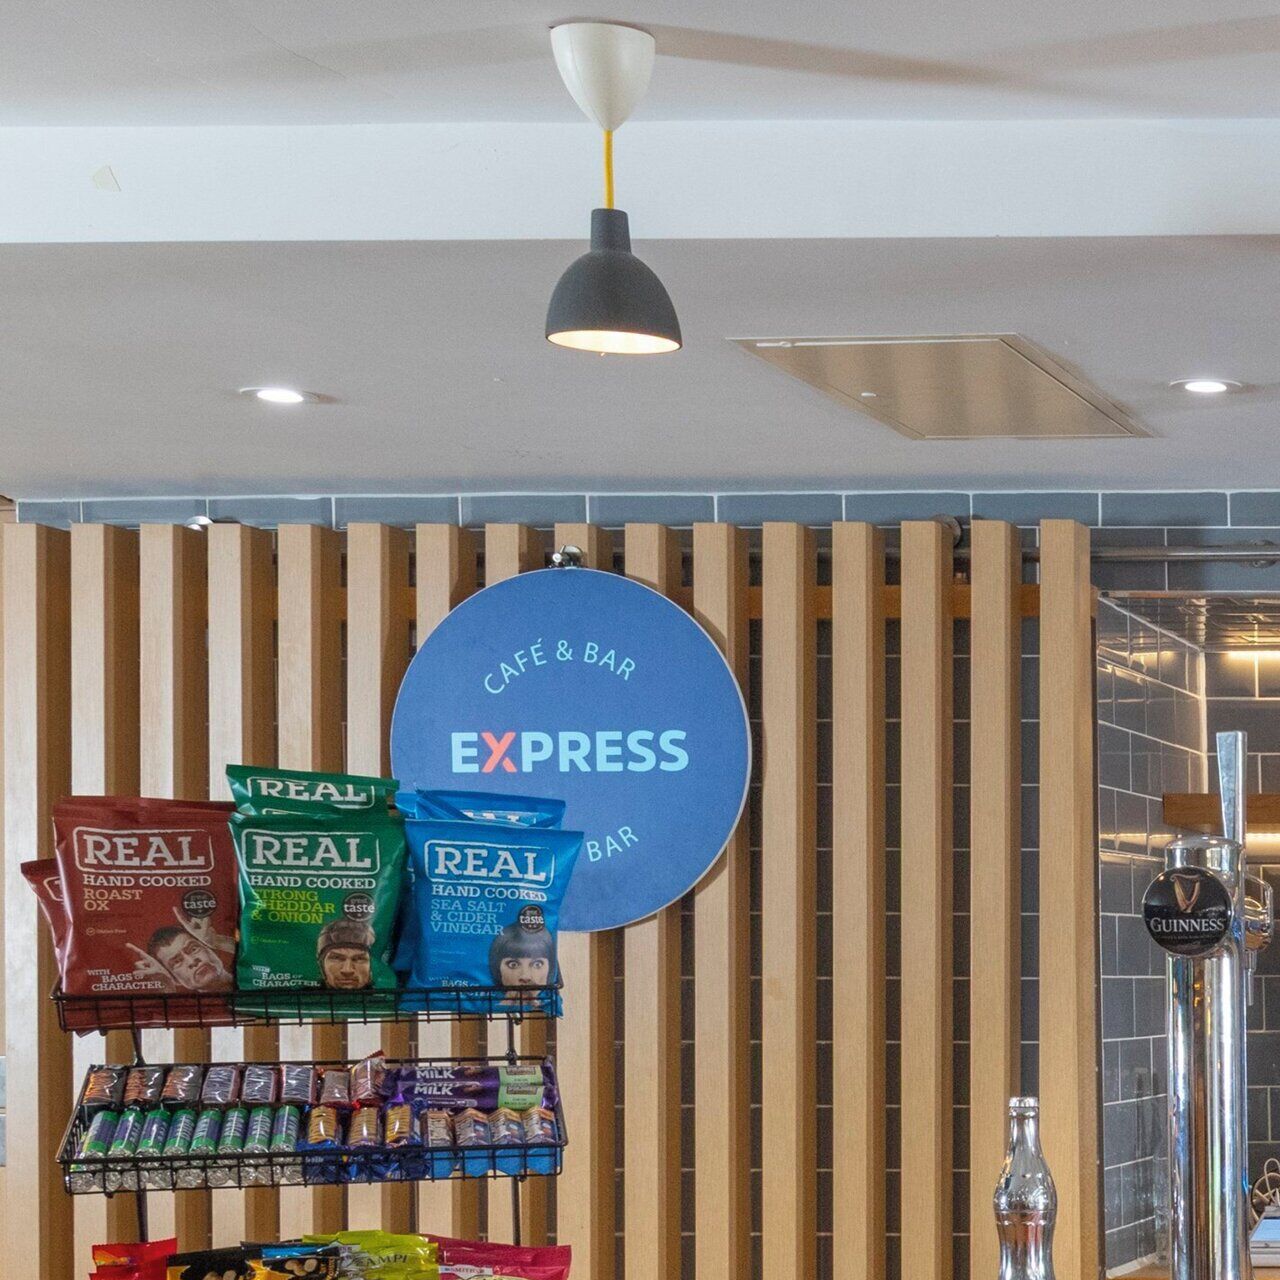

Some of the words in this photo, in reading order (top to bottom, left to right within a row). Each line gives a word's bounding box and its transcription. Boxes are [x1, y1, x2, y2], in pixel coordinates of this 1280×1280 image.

[484, 638, 547, 694] CAFÉ
[556, 640, 573, 661] &
[583, 642, 636, 680] BAR
[451, 730, 689, 773] EXPRESS
[257, 779, 367, 802] REAL
[83, 834, 205, 867] REAL
[252, 835, 371, 868] REAL
[586, 826, 639, 863] BAR
[434, 846, 547, 882] REAL
[83, 874, 134, 887] HAND
[139, 875, 211, 887] COOKED
[250, 875, 301, 887] HAND
[306, 877, 376, 889] COOKED
[84, 888, 143, 900] ROAST
[431, 884, 481, 897] HAND
[484, 887, 548, 901] COOKED
[84, 900, 110, 911] OX
[184, 898, 216, 909] taste
[344, 903, 375, 913] taste
[431, 900, 462, 911] SEA
[467, 900, 506, 912] SALT
[251, 910, 262, 921] &
[268, 911, 323, 924] ONION
[430, 911, 442, 921] &
[447, 911, 497, 923] CIDER
[520, 915, 544, 925] taste
[430, 921, 504, 936] VINEGAR
[1150, 917, 1225, 932] GUINNESS
[102, 974, 133, 982] BAGS
[416, 1069, 455, 1079] MILK
[414, 1085, 453, 1095] MILK
